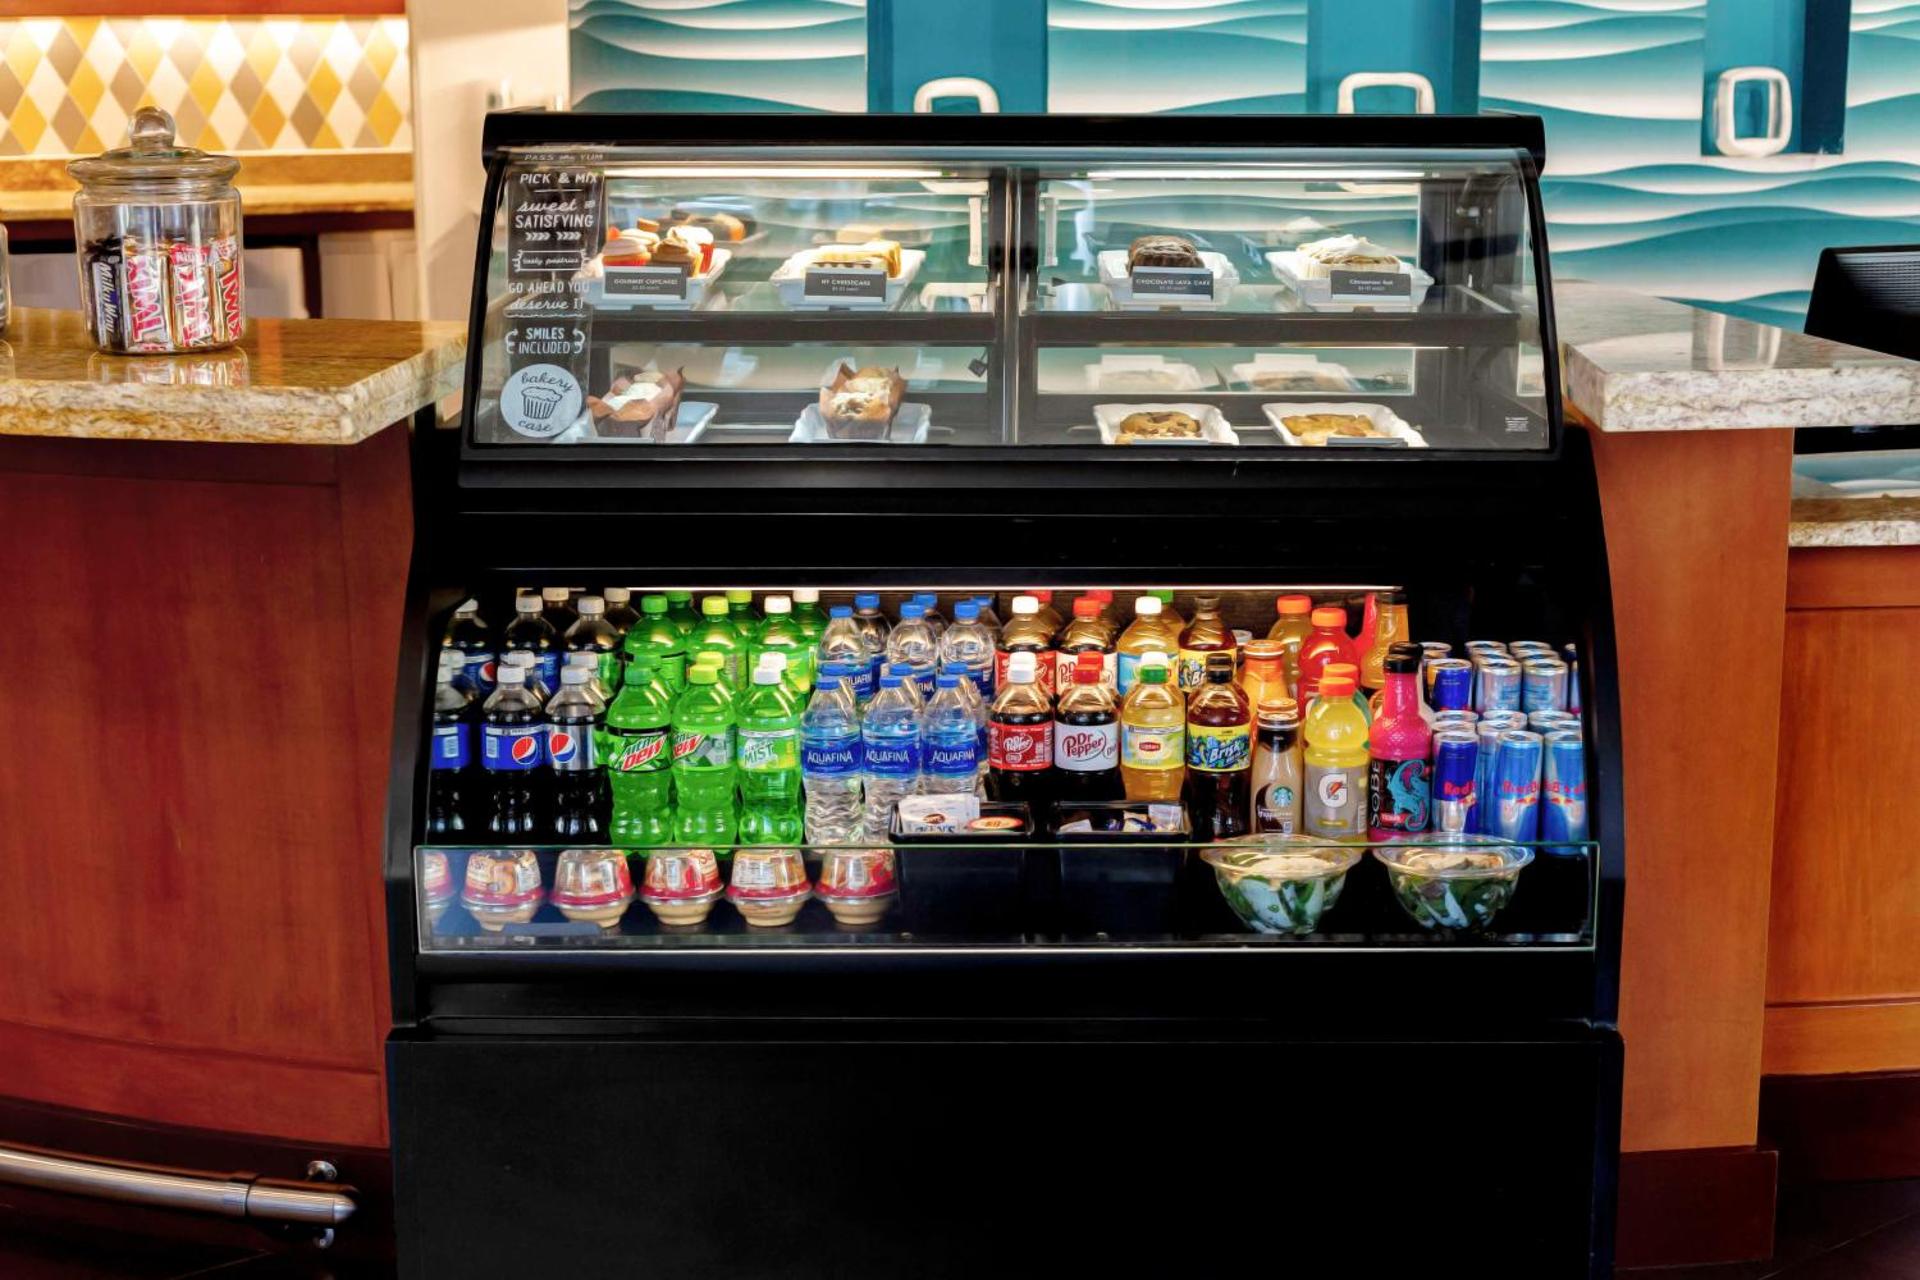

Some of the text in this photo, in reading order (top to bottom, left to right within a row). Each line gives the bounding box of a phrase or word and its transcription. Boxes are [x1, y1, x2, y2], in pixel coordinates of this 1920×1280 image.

[520, 172, 597, 184] PICK & MIX
[517, 199, 577, 212] sweet
[515, 214, 594, 228] SATISFYING
[509, 281, 590, 293] GO AHEAD YOU
[511, 298, 569, 310] deserve
[526, 327, 565, 340] SMILES
[519, 341, 570, 354] INCLUDED
[521, 372, 576, 393] bakery
[518, 419, 553, 432] case
[1063, 732, 1105, 758] Dr Pepper
[744, 743, 774, 765] MIST
[807, 751, 853, 764] AQUAFINA
[865, 750, 910, 763] AQUAFINA
[931, 749, 975, 765] AQUAFINA
[1208, 743, 1241, 763] Brisk
[1319, 773, 1348, 808] G
[1371, 761, 1380, 828] SOBE
